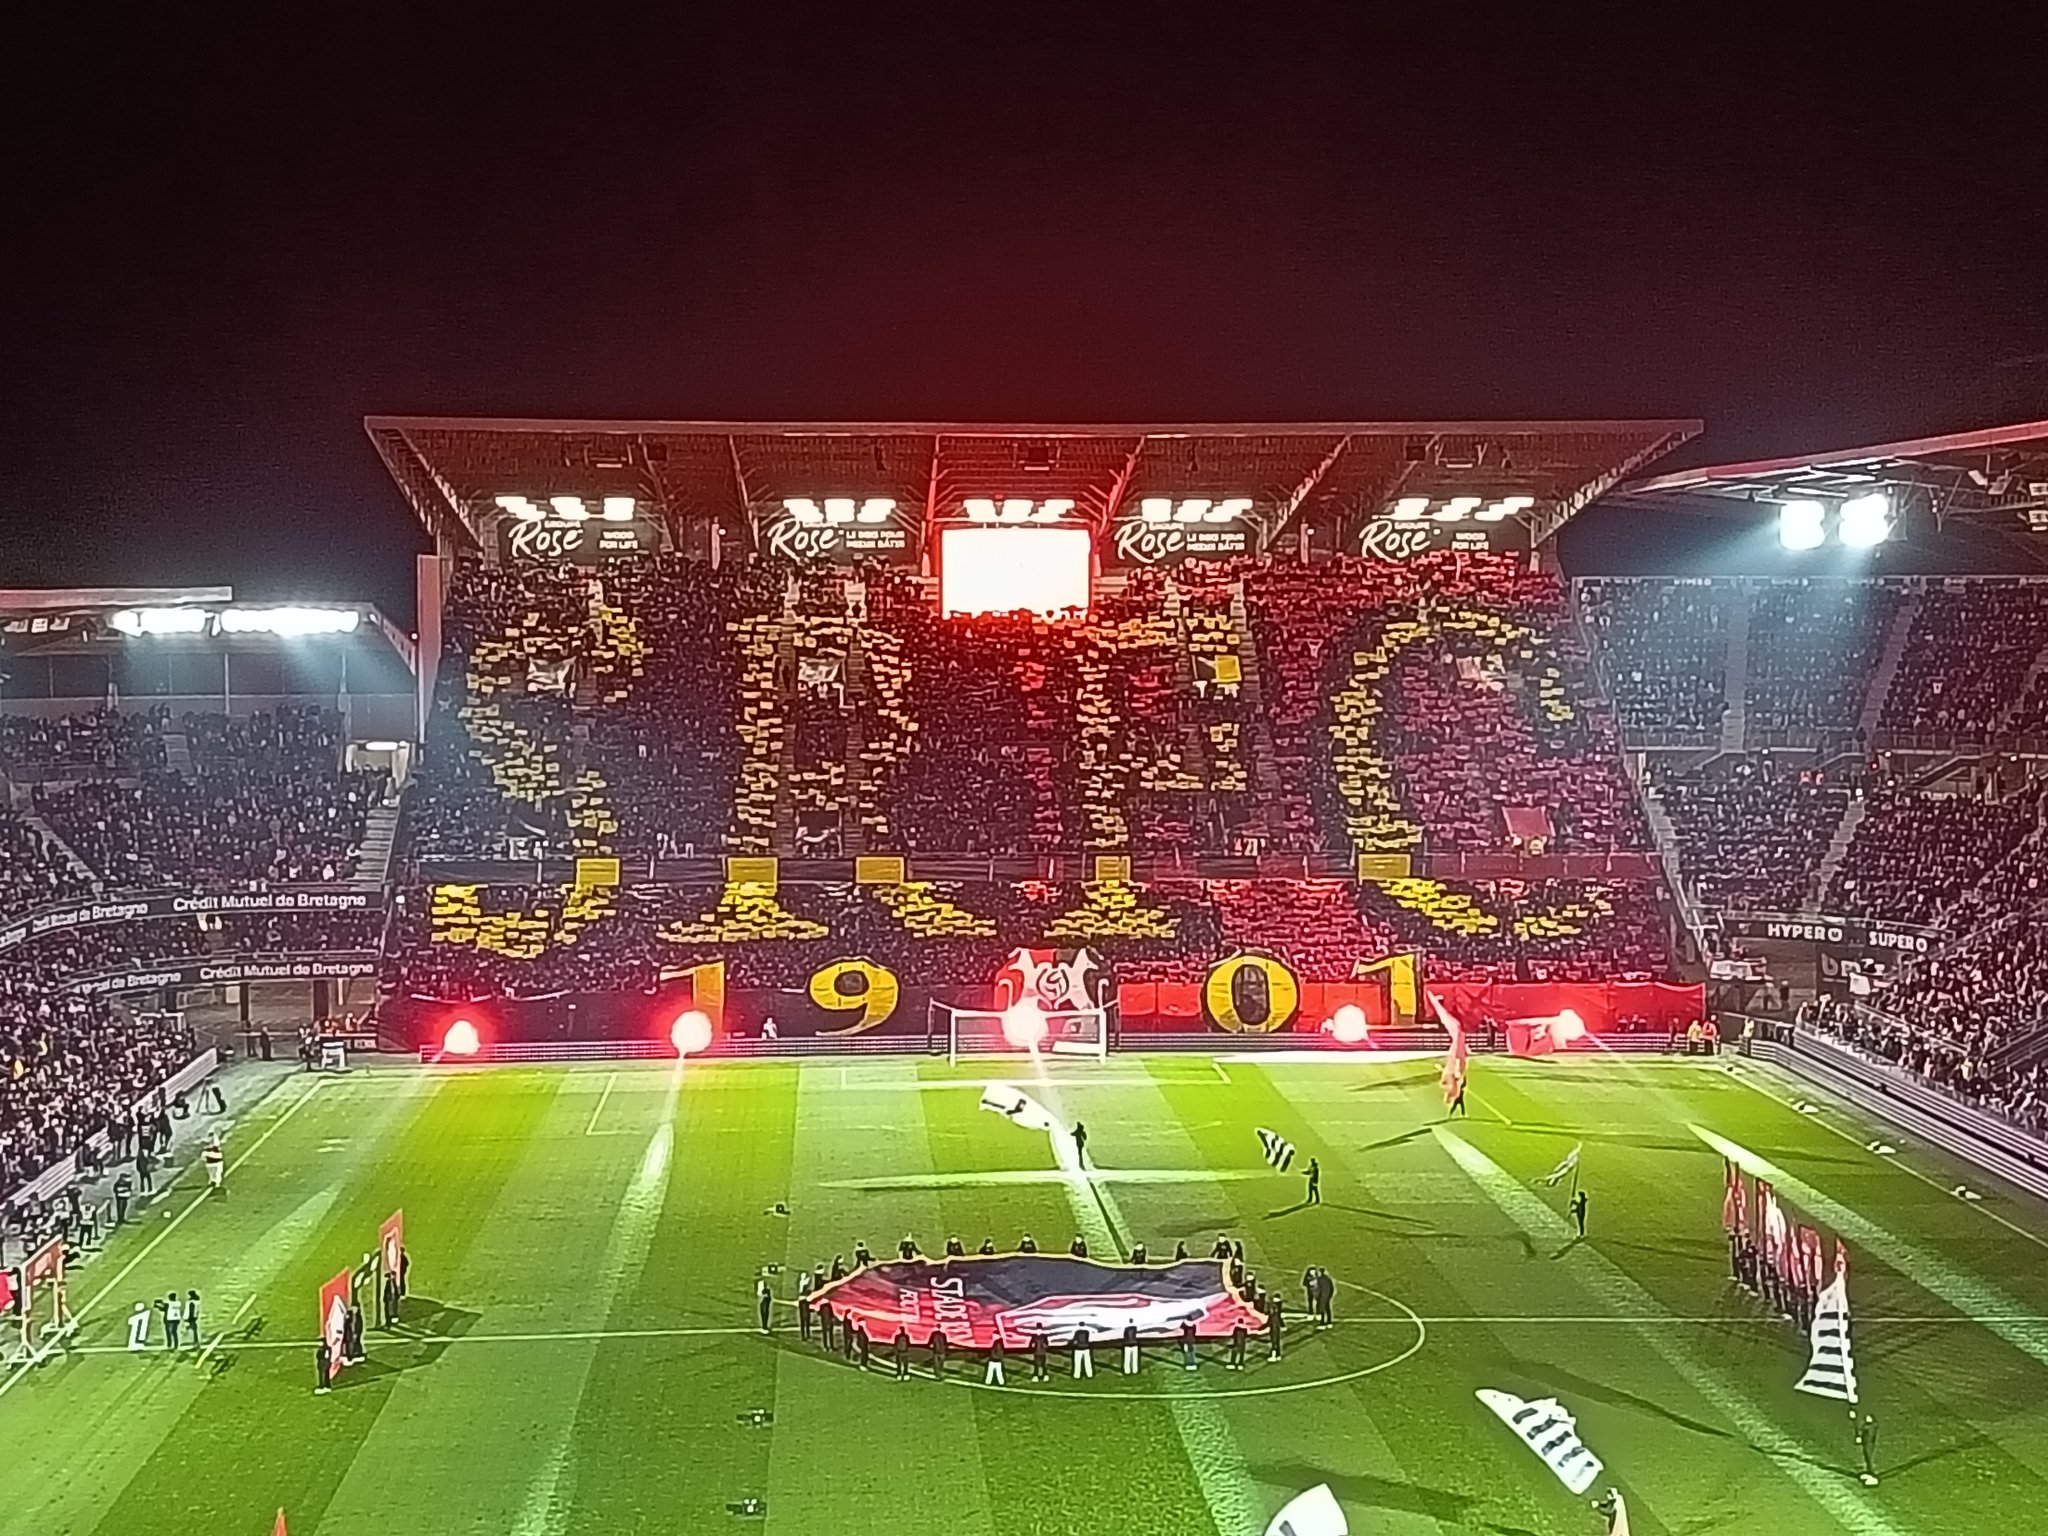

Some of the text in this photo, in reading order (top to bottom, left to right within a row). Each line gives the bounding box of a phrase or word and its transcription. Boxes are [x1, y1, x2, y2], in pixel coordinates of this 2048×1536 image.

[508, 518, 584, 559] Rose
[767, 518, 840, 562] Rose
[1114, 520, 1185, 564] Rose
[1359, 520, 1432, 564] Rose
[173, 893, 367, 912] Crédit Mutuel de Bretagne
[1767, 923, 1826, 941] HYPER
[1869, 931, 1914, 950] SUPER
[200, 963, 374, 980] Crédit Mutuel de Bretagne
[930, 1277, 968, 1320] STADE
